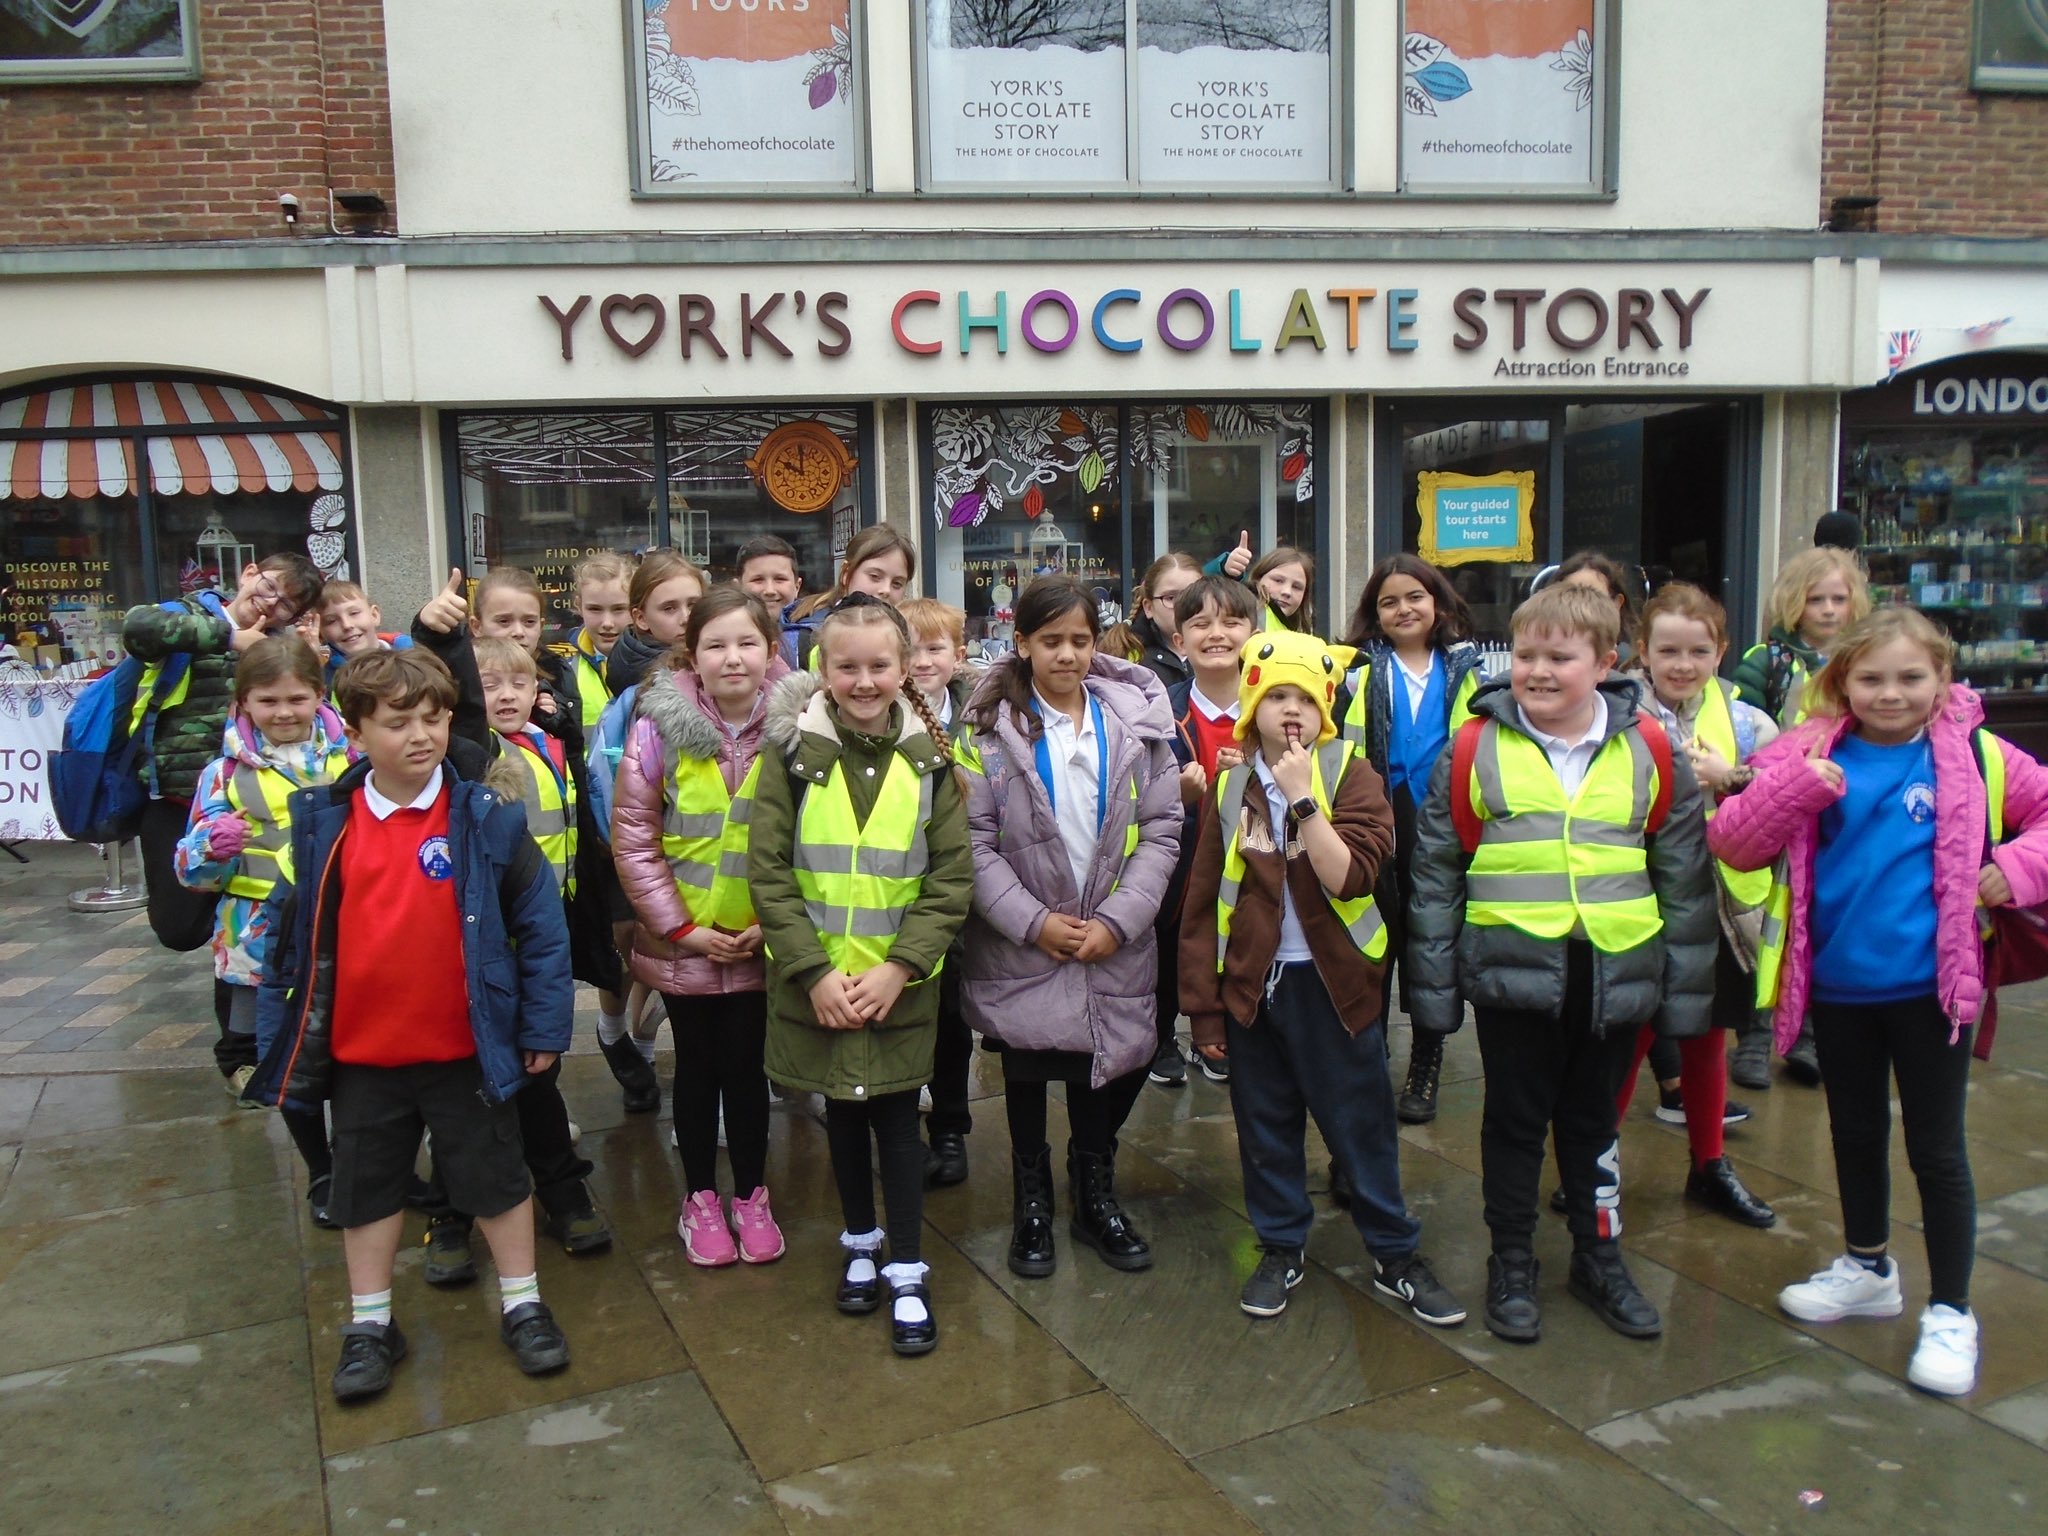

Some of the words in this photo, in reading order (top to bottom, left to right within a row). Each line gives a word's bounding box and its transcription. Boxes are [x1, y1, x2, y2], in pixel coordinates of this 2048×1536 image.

[962, 102, 1091, 118] CHOCOLATE
[1170, 103, 1296, 119] CHOCOLATE
[994, 124, 1060, 140] STORY
[1201, 124, 1265, 140] STORY
[672, 136, 835, 152] #thehomeofchocolate
[1422, 140, 1573, 155] #thehomeofchocolate
[956, 147, 978, 157] THE
[981, 147, 1012, 157] HOME
[1016, 147, 1031, 157] OF
[1034, 147, 1099, 157] CHOCOLATE
[1163, 148, 1184, 157] THE
[1187, 148, 1218, 157] HOME
[1222, 148, 1236, 157] OF
[1240, 148, 1303, 157] CHOCOLATE
[891, 287, 1418, 355] CHOCOLATE
[1453, 287, 1712, 351] STORY
[1494, 357, 1596, 376] Attraction
[1604, 357, 1690, 376] Entrance
[1915, 377, 2048, 413] LONDO
[1443, 500, 1469, 510] Your
[1471, 499, 1510, 512] guided
[1445, 515, 1470, 525] tour
[1472, 515, 1507, 524] starts
[1463, 529, 1489, 539] here
[546, 548, 579, 558] FIND
[6, 562, 77, 573] DISCOVER
[83, 561, 110, 571] THE
[533, 566, 565, 576] WHY
[950, 560, 1008, 572] UNWRAP
[1015, 559, 1039, 569] THE
[1046, 557, 1105, 568] HISTORY
[16, 579, 78, 589] HISTORY
[84, 578, 103, 588] OF
[975, 577, 993, 587] OF
[7, 595, 58, 606] YORK'S
[65, 594, 114, 604] ICONIC
